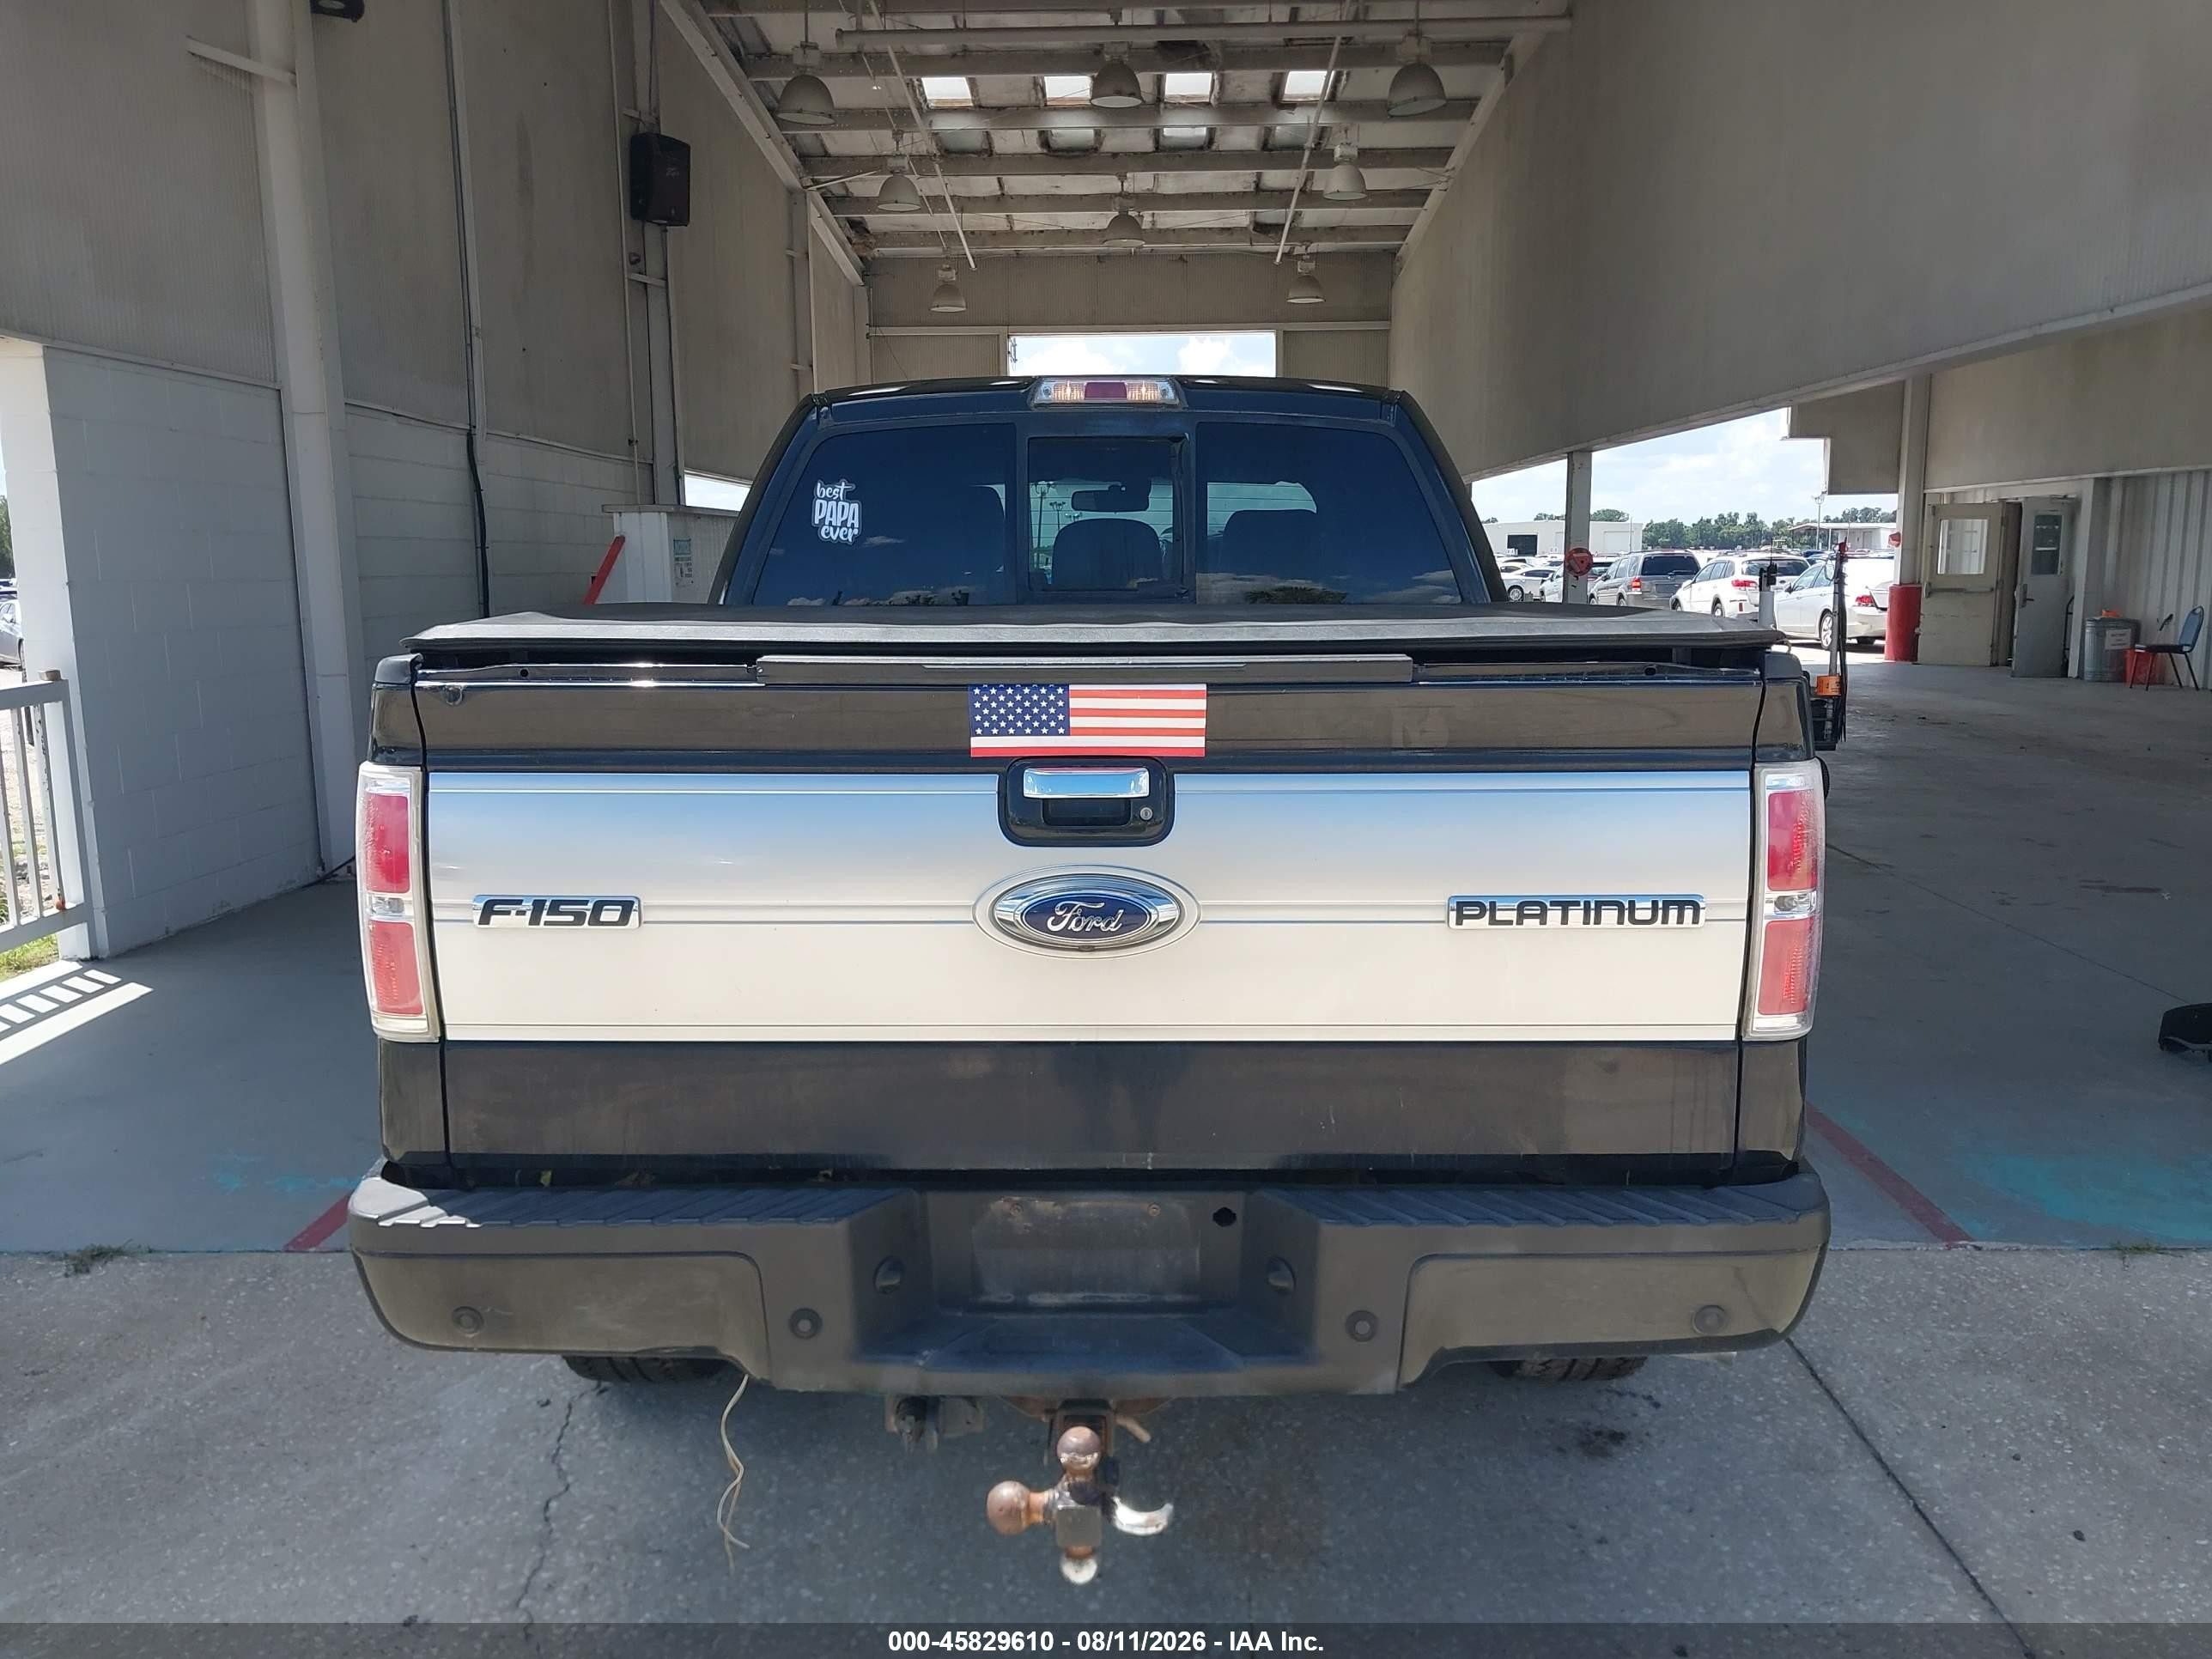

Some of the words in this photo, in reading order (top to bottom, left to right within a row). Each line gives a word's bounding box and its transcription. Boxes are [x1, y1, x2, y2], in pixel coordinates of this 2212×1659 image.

[817, 482, 853, 501] best
[814, 499, 860, 528] PAPA
[820, 526, 859, 543] ever
[477, 898, 635, 927] F-150
[1047, 901, 1125, 933] Ford
[1455, 899, 1702, 927] PLATINUM
